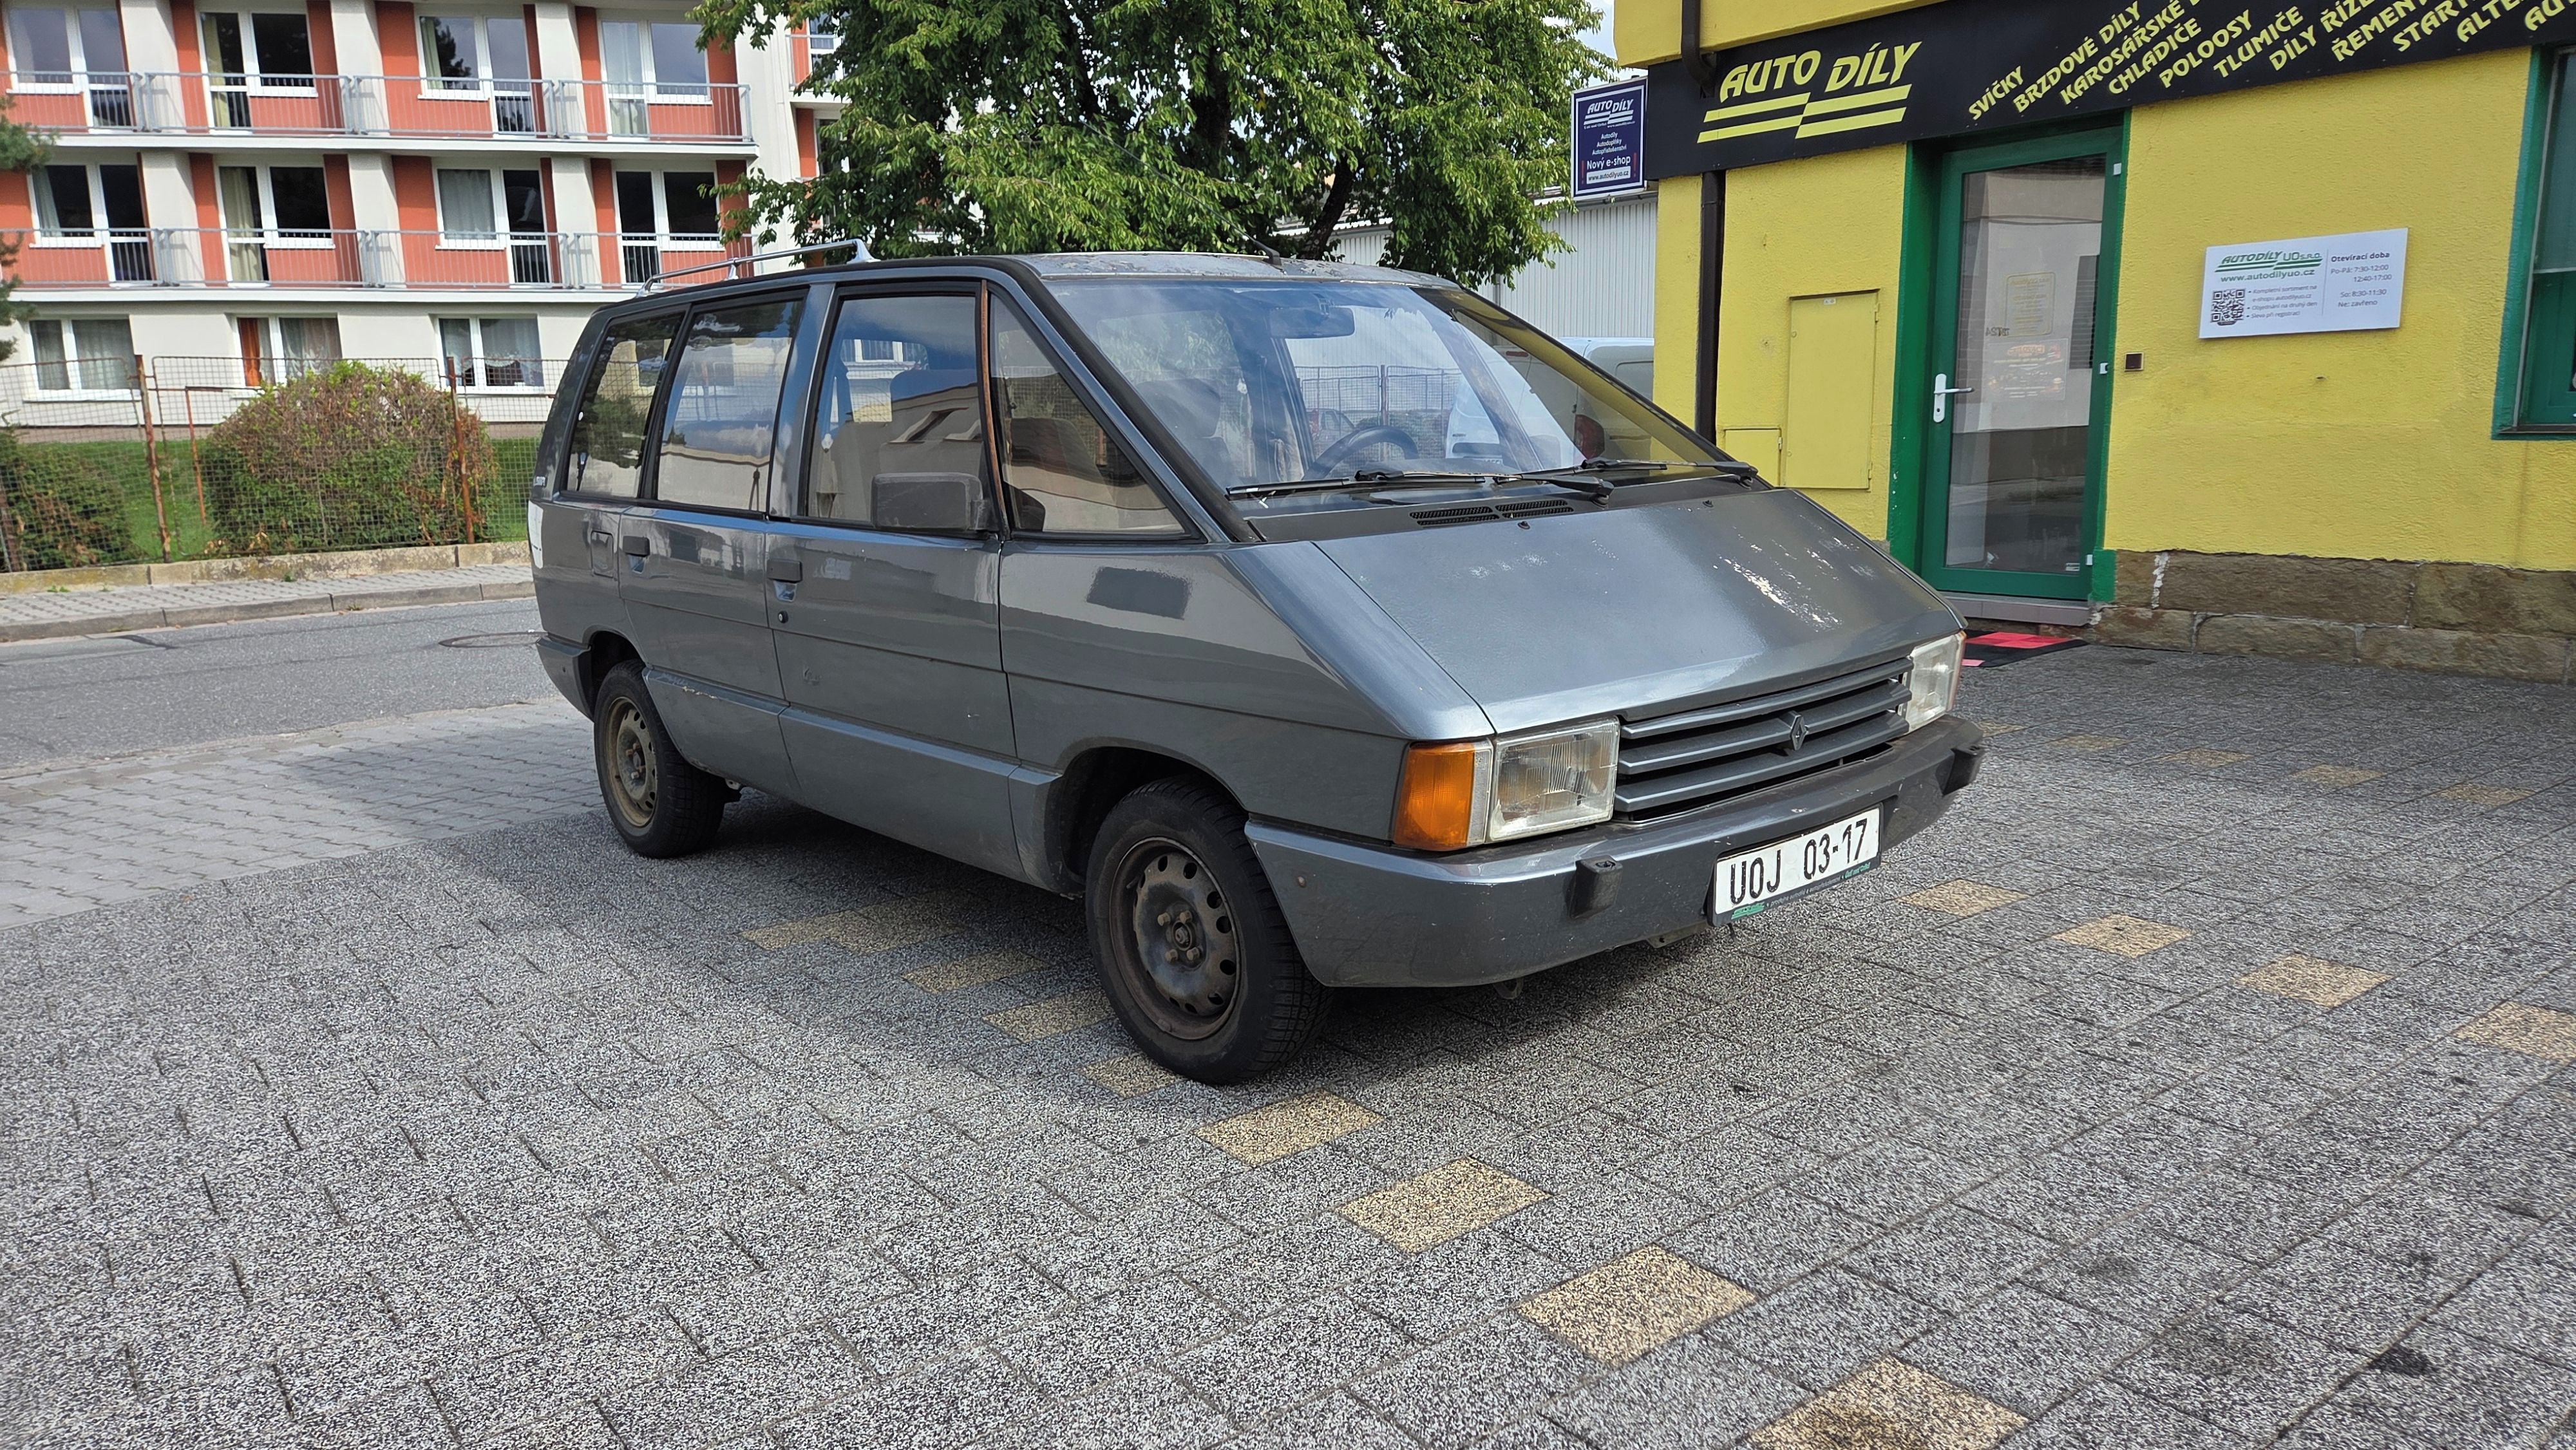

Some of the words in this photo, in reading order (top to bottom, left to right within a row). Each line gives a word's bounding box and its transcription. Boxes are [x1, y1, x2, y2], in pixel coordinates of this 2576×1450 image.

[2213, 6, 2304, 78] TLUMIČE
[2269, 24, 2316, 71] DÍLY
[2320, 0, 2375, 33] ŘÍZ
[2331, 0, 2427, 62] ŘEMEN
[2524, 0, 2576, 31] AU
[1719, 50, 1821, 104] AUTO
[1824, 41, 1922, 93] DÍLY
[2012, 36, 2099, 113] BRZDOVÉ
[2098, 1, 2140, 44] DÍLY
[2060, 0, 2184, 105] KAROSÁŘSKÉ
[2108, 17, 2202, 94] CHLADIČE
[2159, 9, 2251, 88] POLOOSY
[1968, 66, 2023, 120] SVÍČKY
[1587, 157, 1605, 170] Nový
[1606, 156, 1631, 166] e-shop
[2221, 250, 2283, 264] AUTODÍLY
[2221, 269, 2315, 282] www.autodilyuo.cz
[2331, 252, 2369, 262] Otevírací
[1730, 849, 1781, 905] UOJ
[1803, 818, 1868, 880] 03-17
